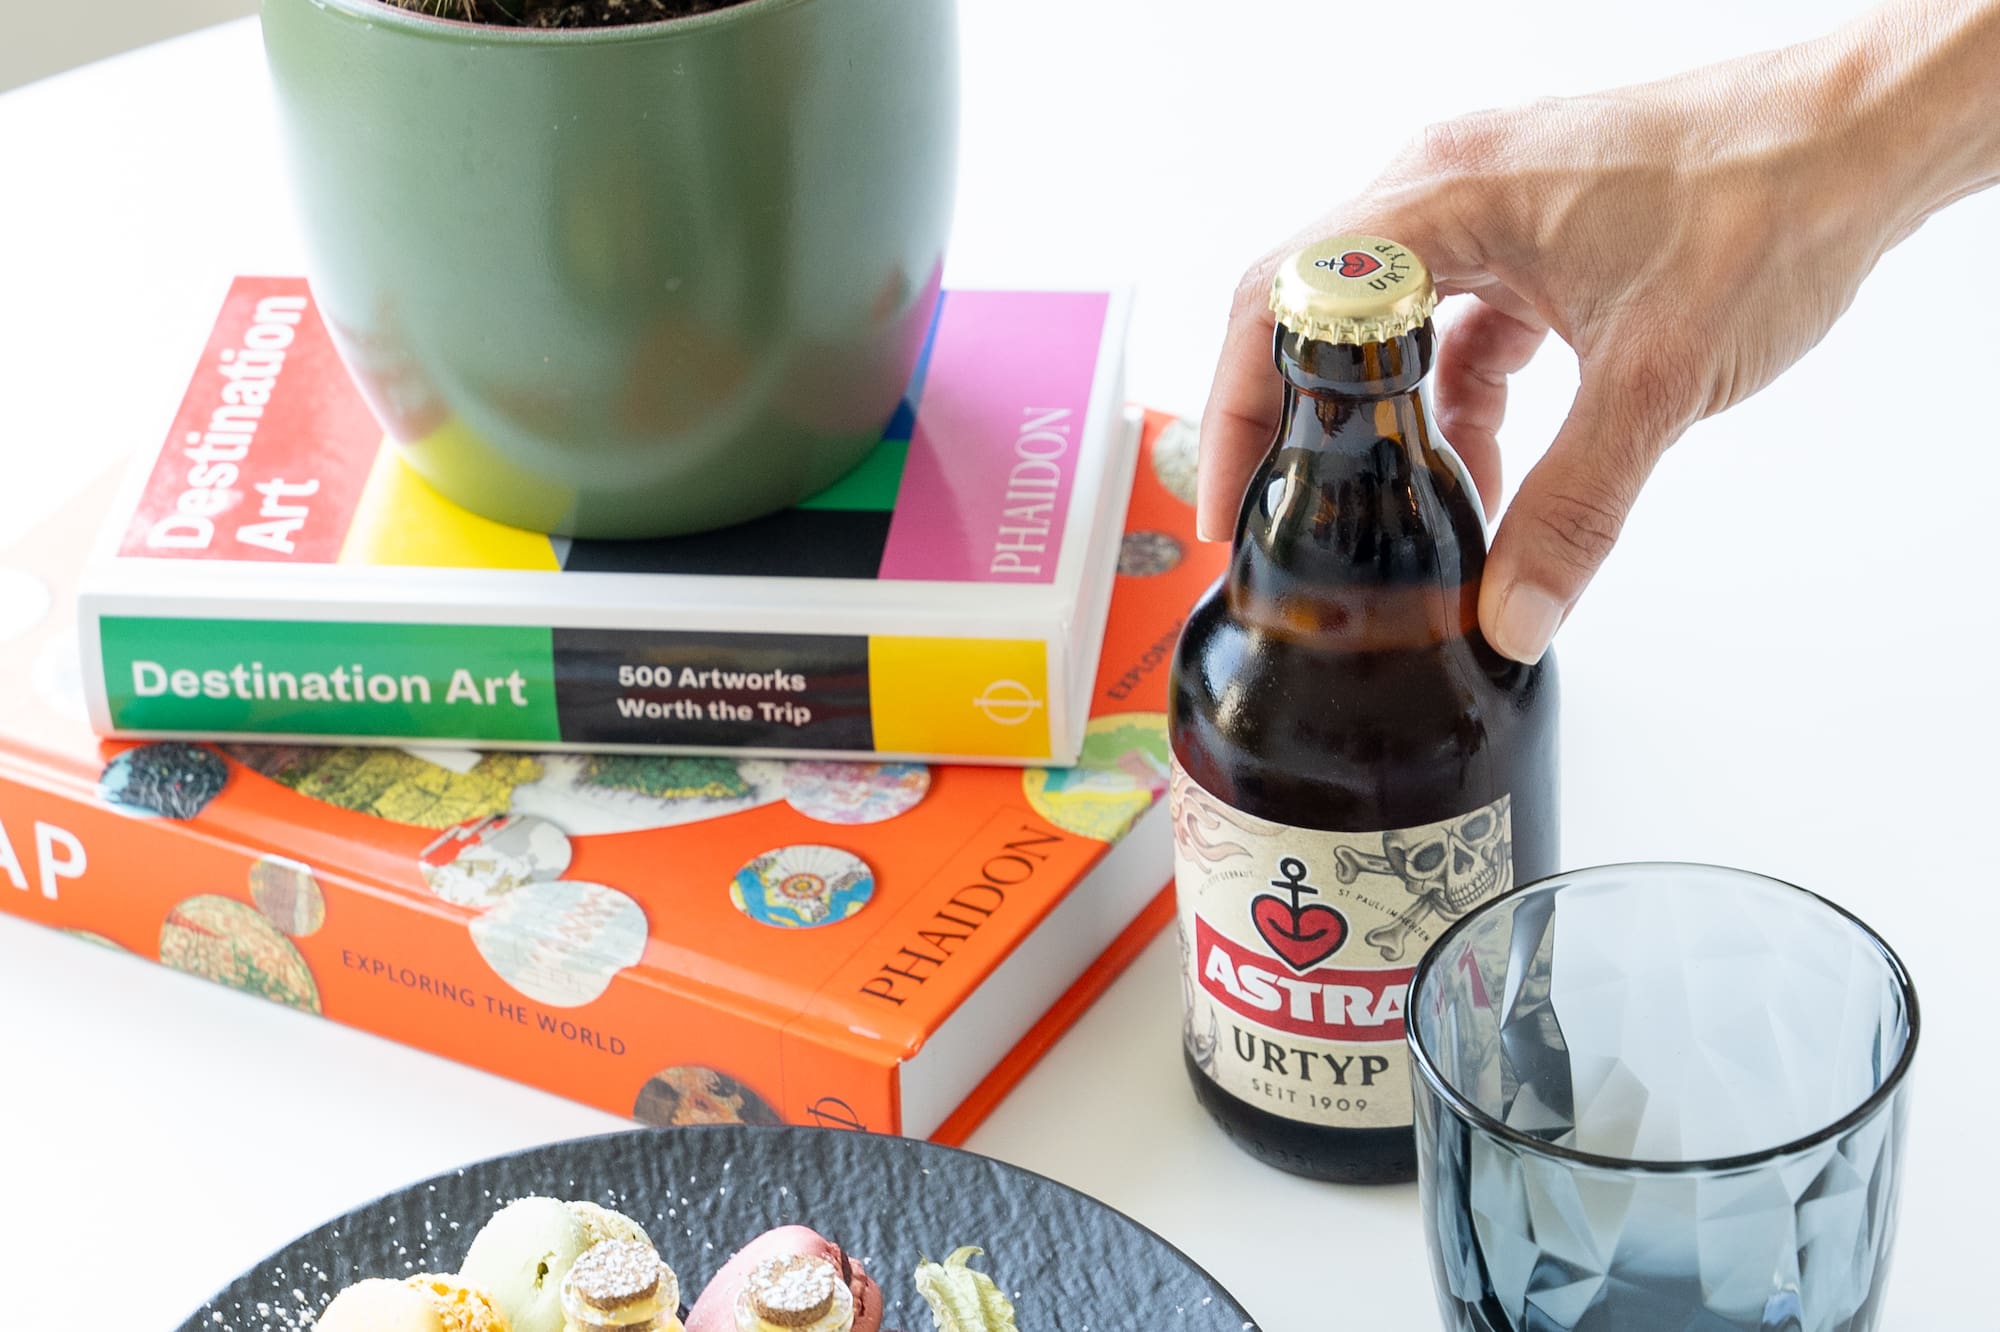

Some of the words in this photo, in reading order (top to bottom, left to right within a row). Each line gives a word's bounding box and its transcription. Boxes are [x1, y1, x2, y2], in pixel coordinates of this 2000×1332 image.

[1368, 244, 1410, 292] URTYP
[146, 296, 308, 549] Destination
[235, 478, 320, 554] Art
[990, 406, 1073, 575] PHAIDON
[132, 660, 431, 704] Destination
[445, 668, 529, 706] Art
[616, 698, 703, 720] Worth
[707, 700, 754, 721] the
[757, 701, 812, 727] Trip
[618, 665, 673, 687] 500
[677, 667, 807, 692] Artworks
[858, 825, 1064, 1007] PHAIDON
[341, 949, 476, 1008] EXPLORING
[483, 995, 529, 1026] THE
[536, 1011, 627, 1056] WORLD
[1204, 944, 1409, 1027] ASTRA
[1232, 1025, 1390, 1087] URTYP
[1251, 1077, 1297, 1104] SEIT
[1309, 1094, 1368, 1113] 1909
